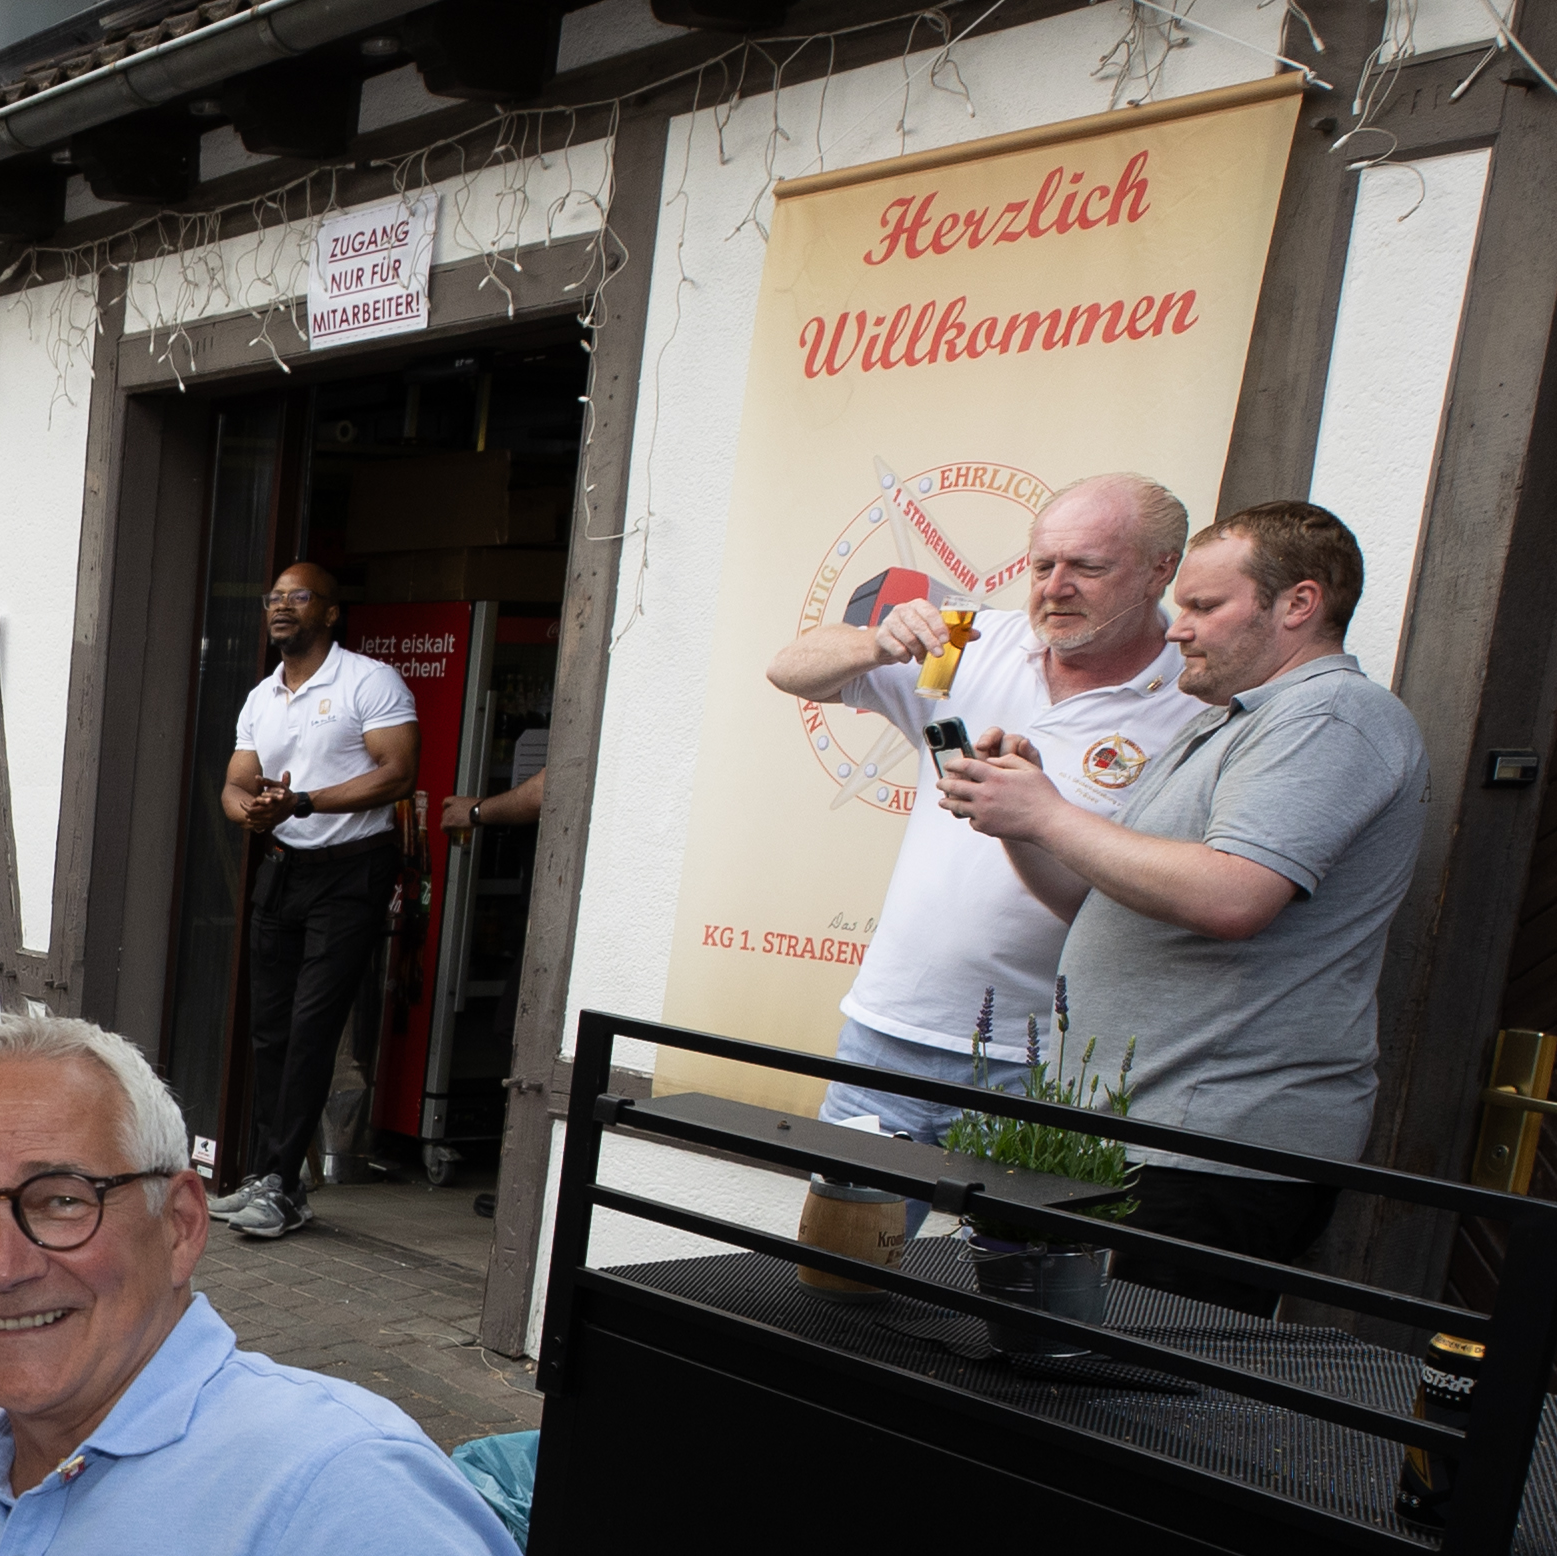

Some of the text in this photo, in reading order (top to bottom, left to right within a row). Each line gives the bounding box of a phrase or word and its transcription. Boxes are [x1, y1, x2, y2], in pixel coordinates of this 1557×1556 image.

[863, 149, 1151, 266] Herzlich
[329, 220, 409, 259] ZUGANG
[330, 256, 401, 294] NUR FÜR
[312, 290, 420, 333] MITARBEITER!
[799, 289, 1200, 379] Willkommen
[357, 632, 455, 653] Jetzt eiskalt
[702, 924, 871, 967] KG 1. STRAßEN
